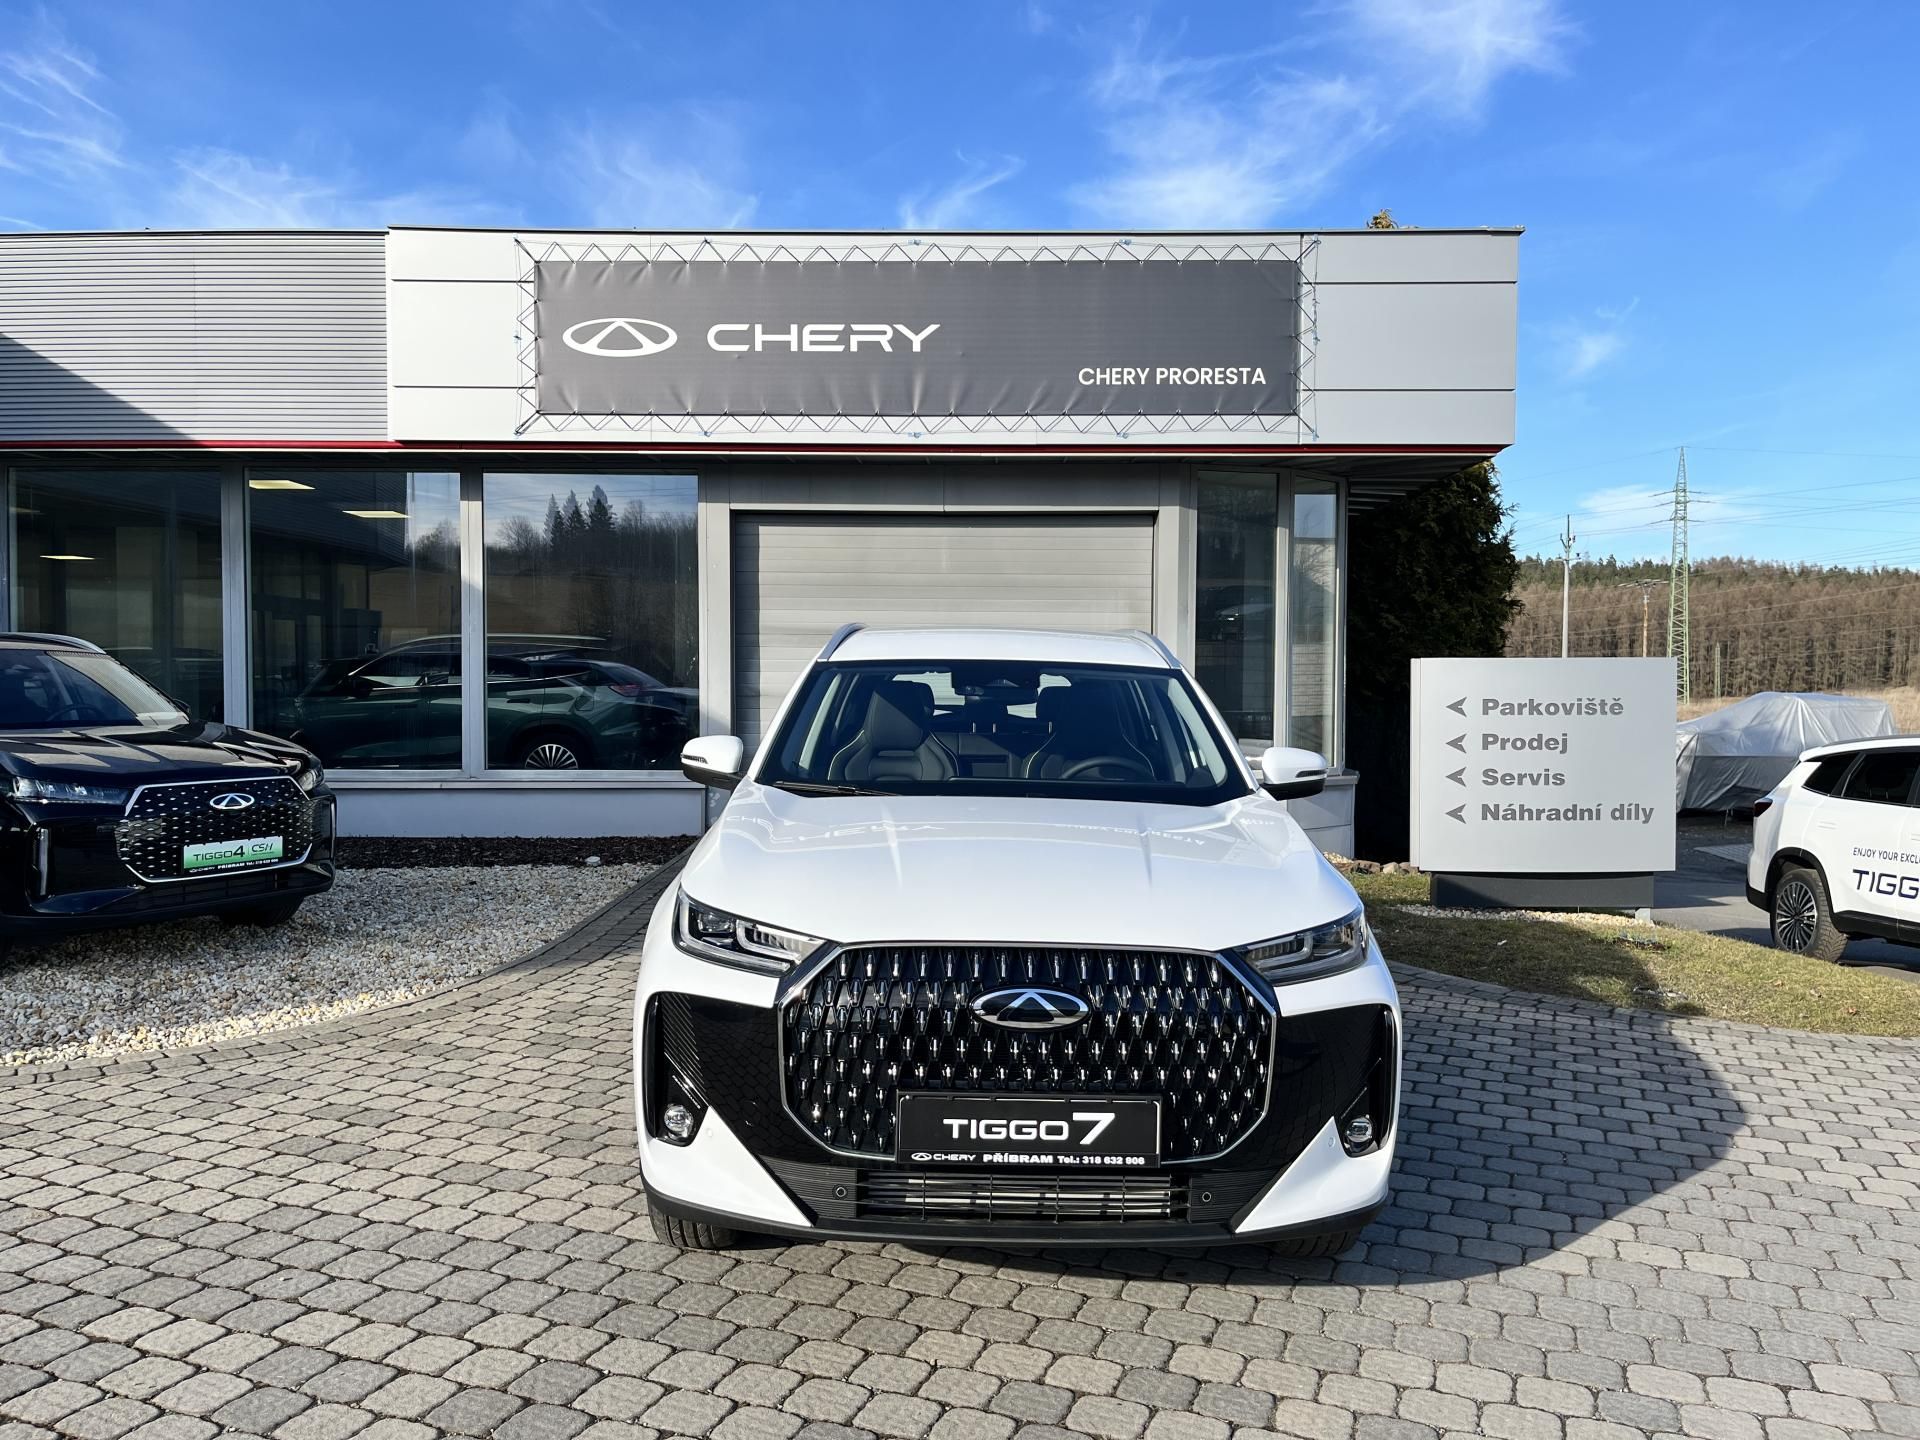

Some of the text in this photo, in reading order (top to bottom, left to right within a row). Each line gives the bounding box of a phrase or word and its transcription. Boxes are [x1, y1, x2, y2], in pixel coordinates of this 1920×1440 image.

[707, 324, 941, 352] CHERY
[1078, 367, 1266, 386] CHERY PRORESTA
[1481, 697, 1625, 716] Parkoviště
[1481, 733, 1569, 755] Prodej
[1481, 768, 1566, 786] Servis
[1481, 803, 1655, 824] Náhradní díly
[1853, 847, 1920, 864] ENJOY YOUR EXCL
[933, 1153, 977, 1162] CHERY
[983, 1152, 1054, 1164] PŘÍBRAM
[1057, 1155, 1080, 1164] Tel.:
[1082, 1155, 1102, 1164] 318
[1103, 1156, 1124, 1165] 632
